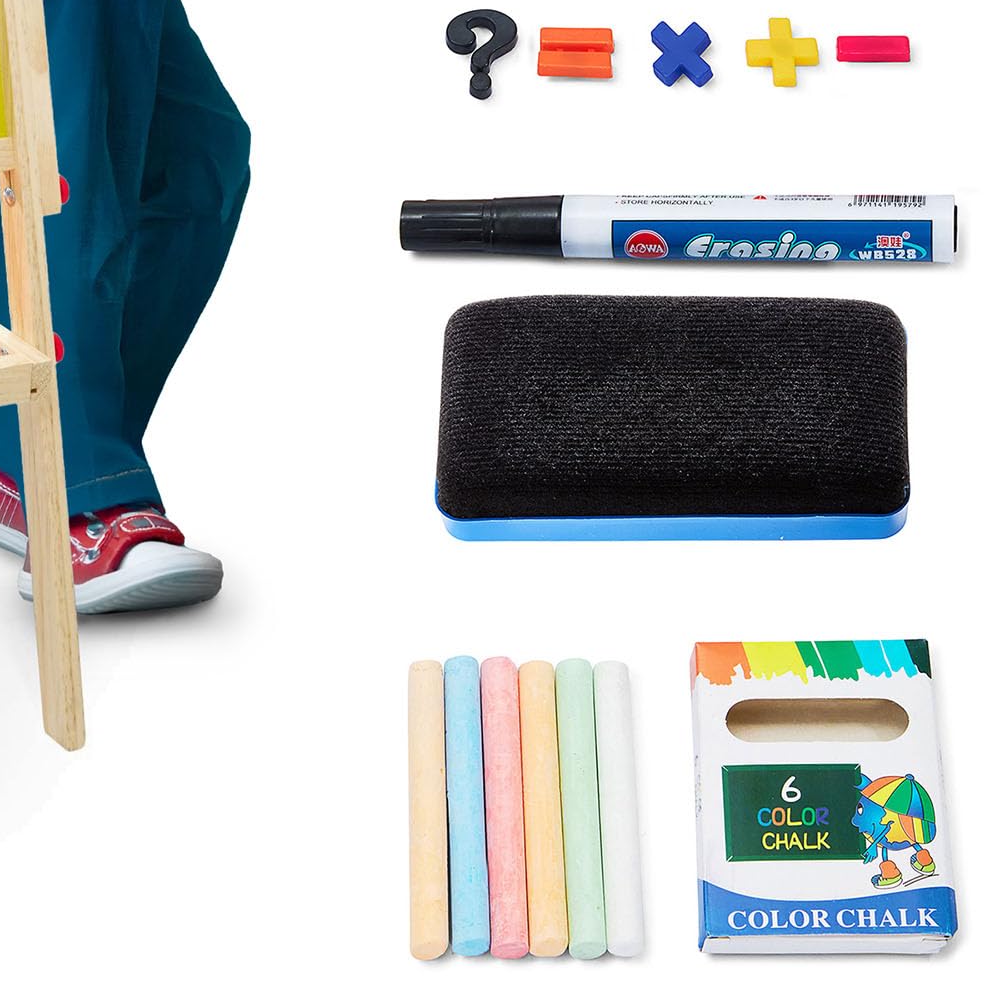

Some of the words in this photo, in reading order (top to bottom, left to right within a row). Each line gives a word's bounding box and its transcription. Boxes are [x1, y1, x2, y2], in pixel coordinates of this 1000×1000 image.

[858, 248, 917, 260] WB528
[780, 775, 802, 803] 6
[757, 806, 830, 828] COLOR
[762, 831, 831, 851] CHALK
[727, 909, 831, 931] COLOR
[837, 907, 940, 929] CHALK
